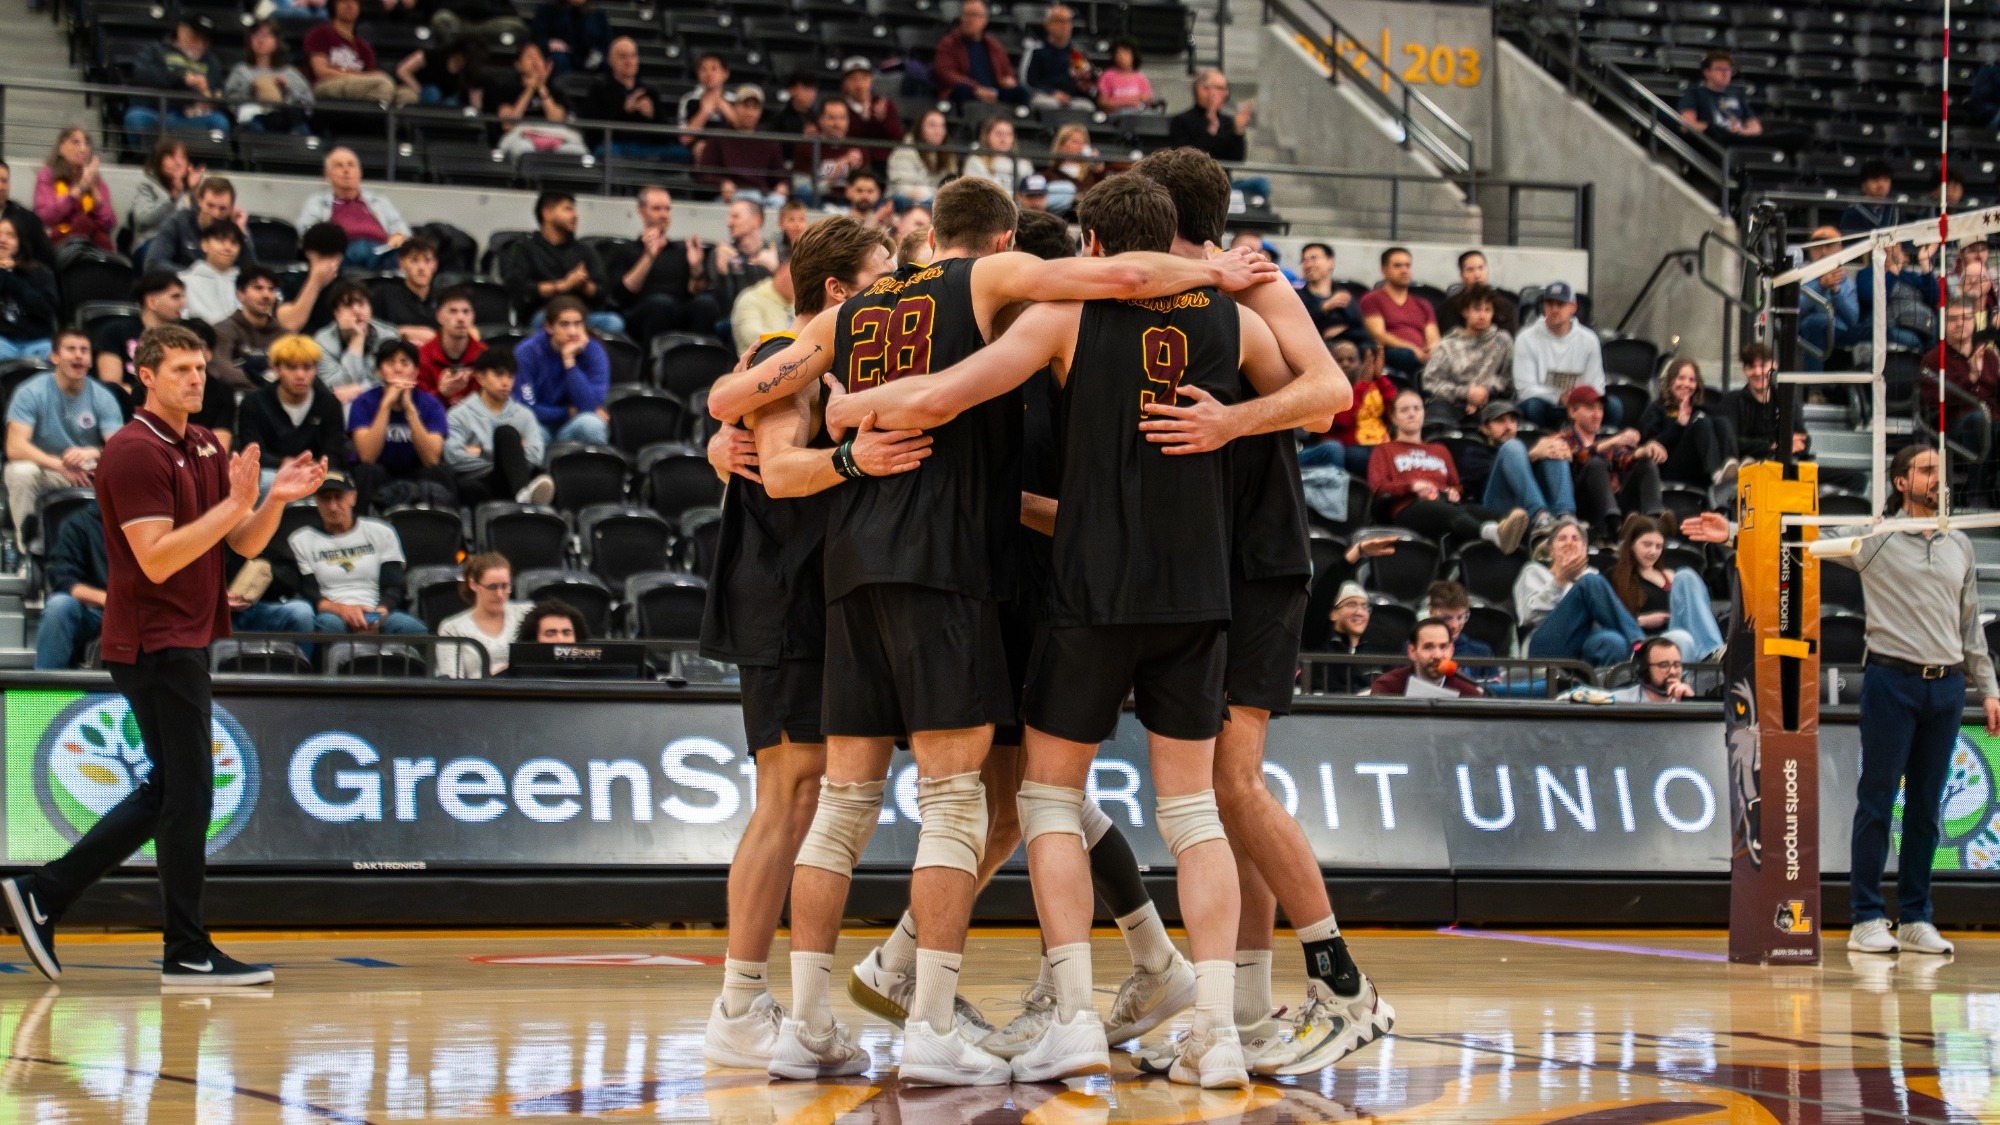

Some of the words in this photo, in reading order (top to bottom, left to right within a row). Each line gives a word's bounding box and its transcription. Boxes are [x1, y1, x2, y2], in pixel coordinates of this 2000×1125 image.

[1402, 43, 1482, 87] 203
[848, 294, 936, 394] 28
[1140, 325, 1188, 419] 9
[1783, 759, 1799, 814] sports
[352, 861, 427, 870] DAKTRONICS
[1783, 815, 1799, 881] imports
[1788, 900, 1813, 935] L
